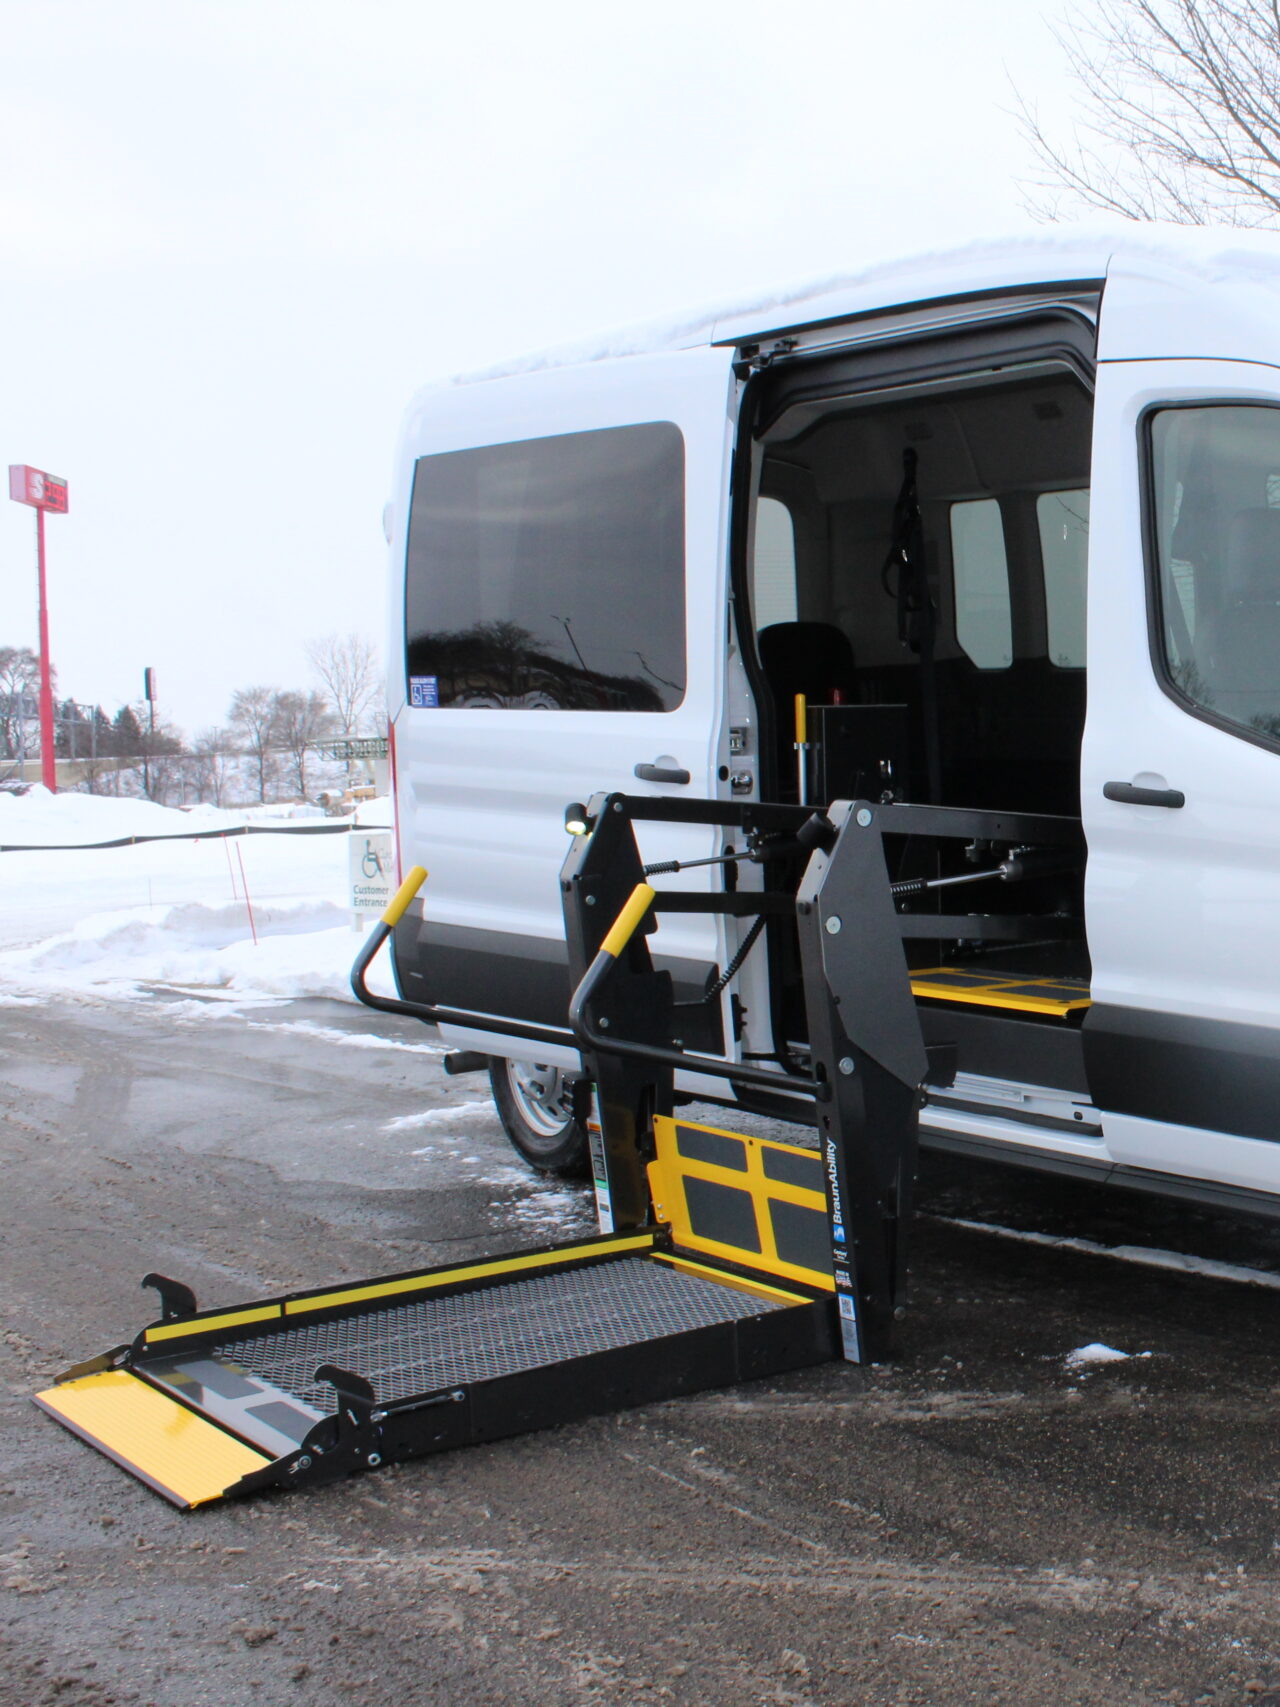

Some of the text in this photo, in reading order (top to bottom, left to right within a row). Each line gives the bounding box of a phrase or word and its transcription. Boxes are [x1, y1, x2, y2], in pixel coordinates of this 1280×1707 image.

[353, 885, 390, 895] Customer
[353, 897, 388, 907] Entrance
[826, 1136, 842, 1224] BraunAbility
